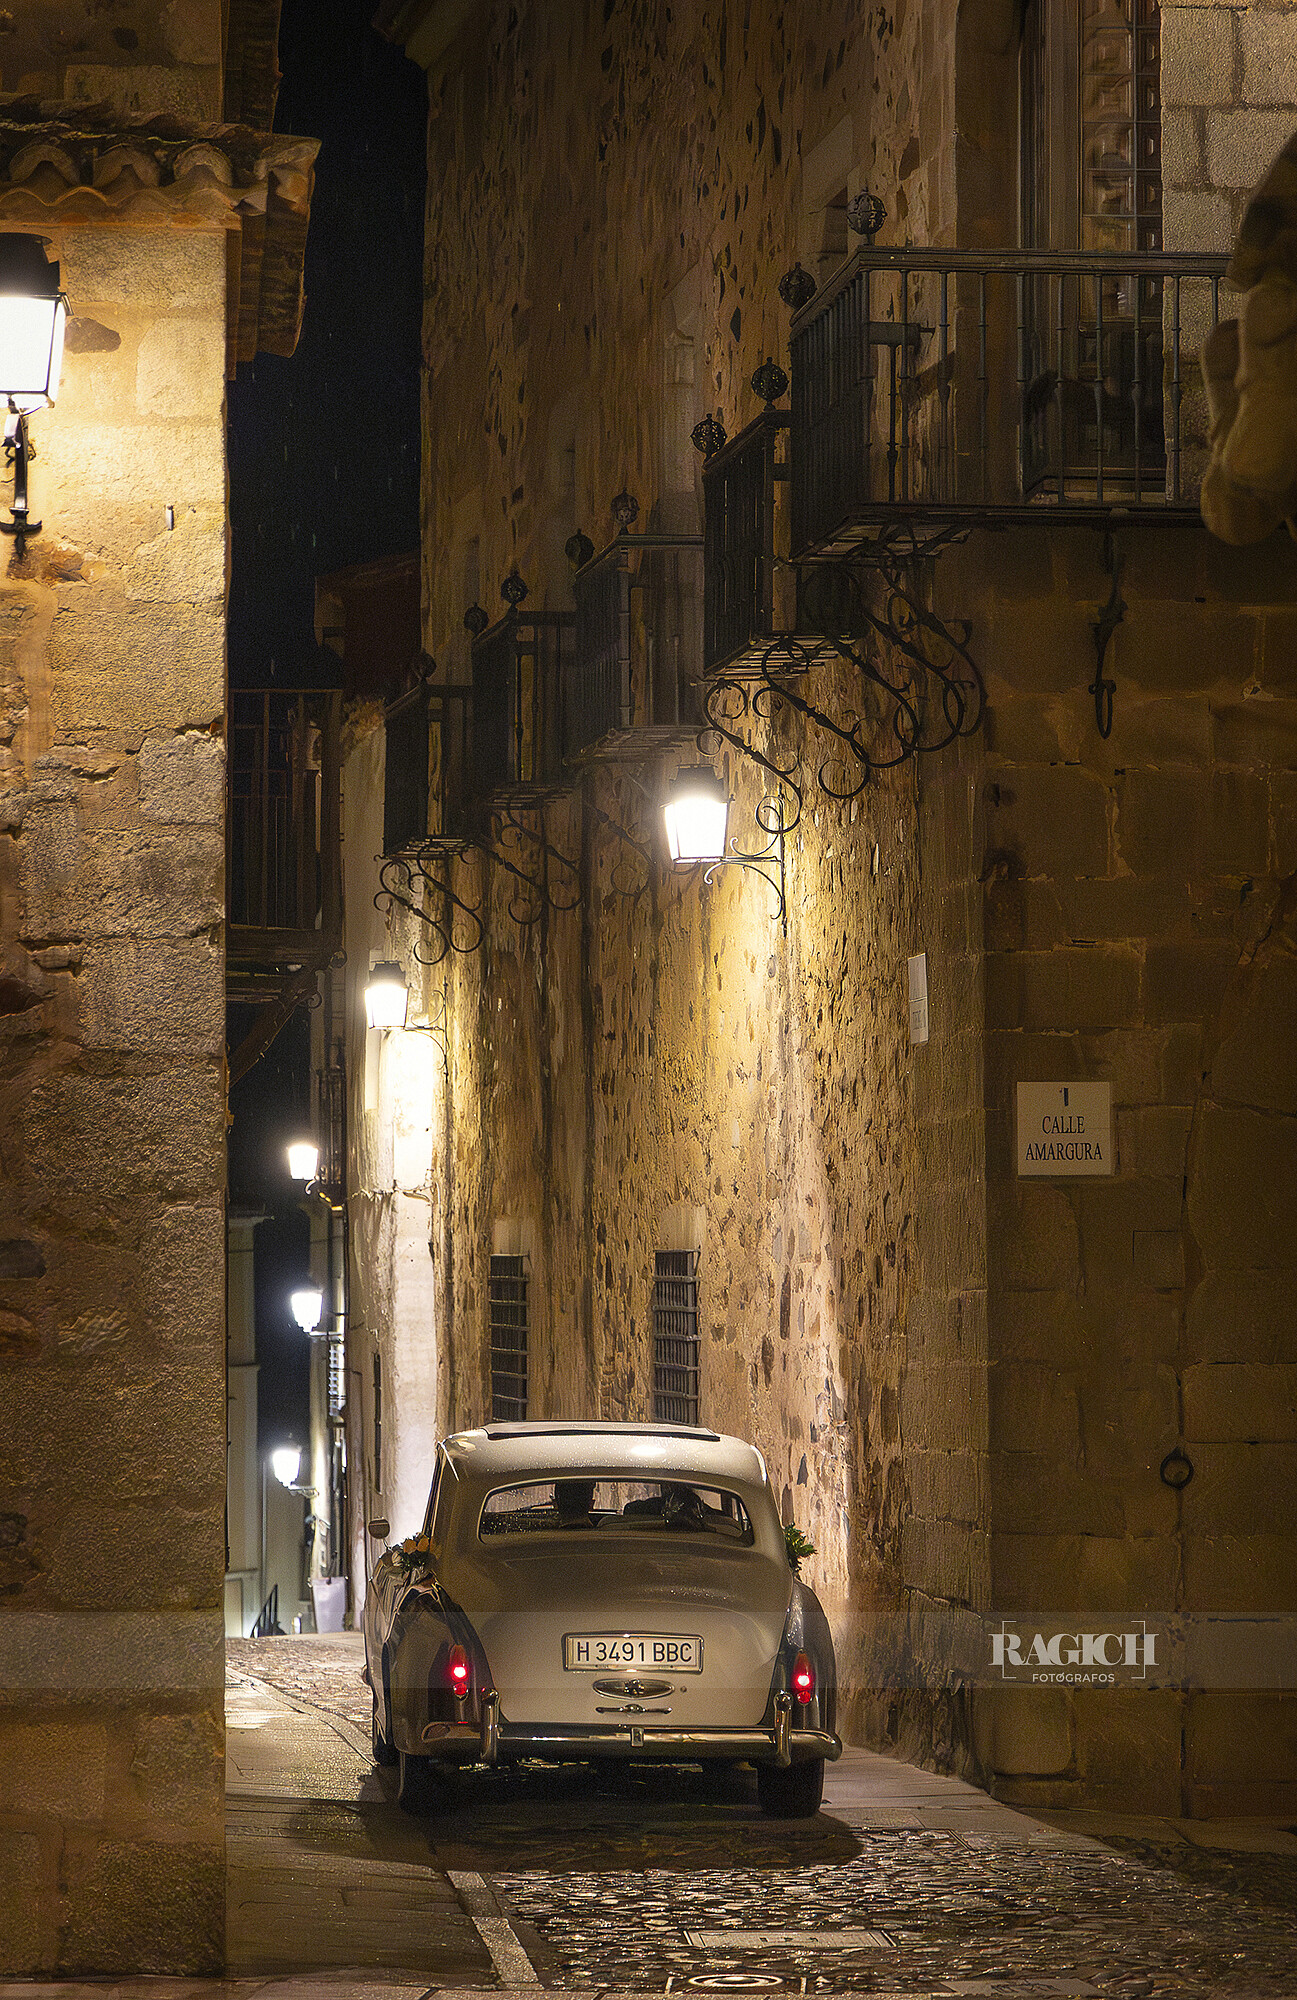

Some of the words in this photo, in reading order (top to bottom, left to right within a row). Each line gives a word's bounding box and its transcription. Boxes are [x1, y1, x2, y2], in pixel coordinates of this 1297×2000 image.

[1042, 1115, 1086, 1135] CALLE
[1025, 1142, 1103, 1161] AMARGURA
[577, 1641, 590, 1662] H
[595, 1641, 646, 1662] 3491
[652, 1642, 693, 1663] BBC
